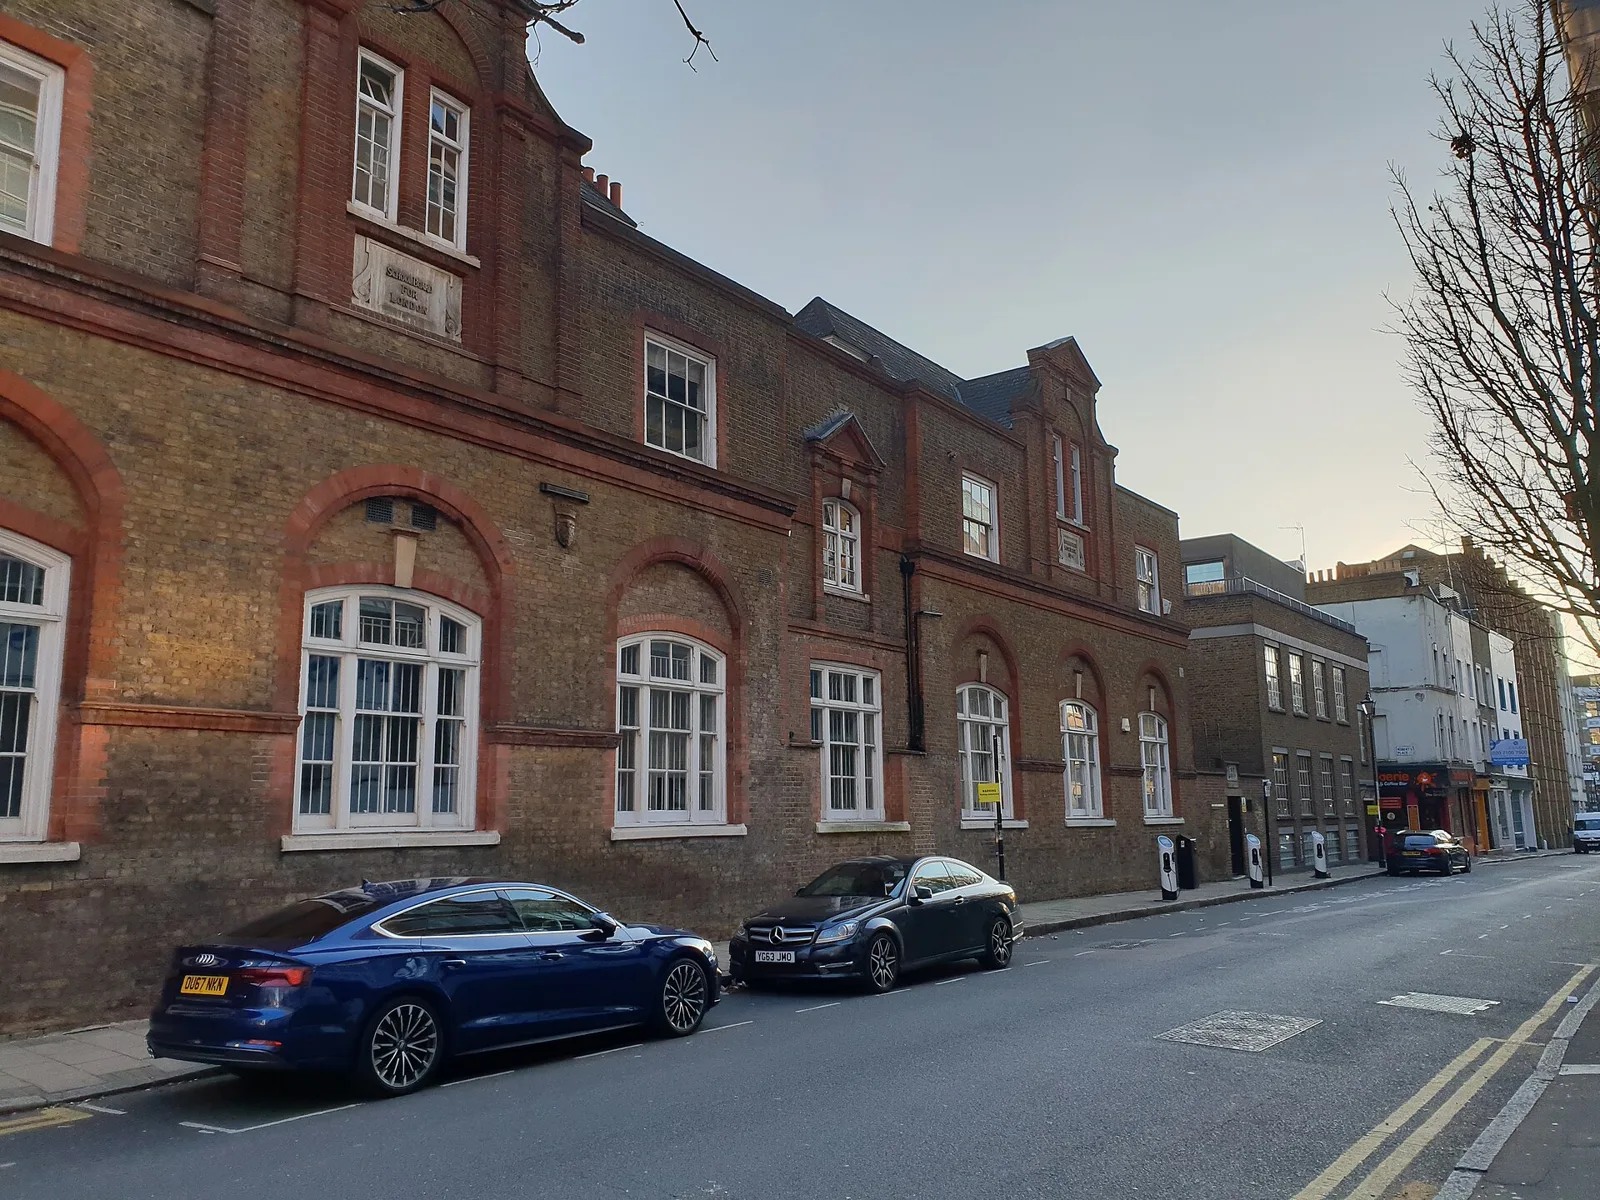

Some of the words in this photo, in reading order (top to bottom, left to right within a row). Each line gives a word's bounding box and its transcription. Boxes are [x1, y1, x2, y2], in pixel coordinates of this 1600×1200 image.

[400, 284, 418, 301] FOR
[389, 292, 428, 315] LONDON
[757, 952, 775, 961] YG63
[776, 952, 792, 961] JMO
[184, 976, 206, 990] OU67
[206, 977, 225, 992] NKN
